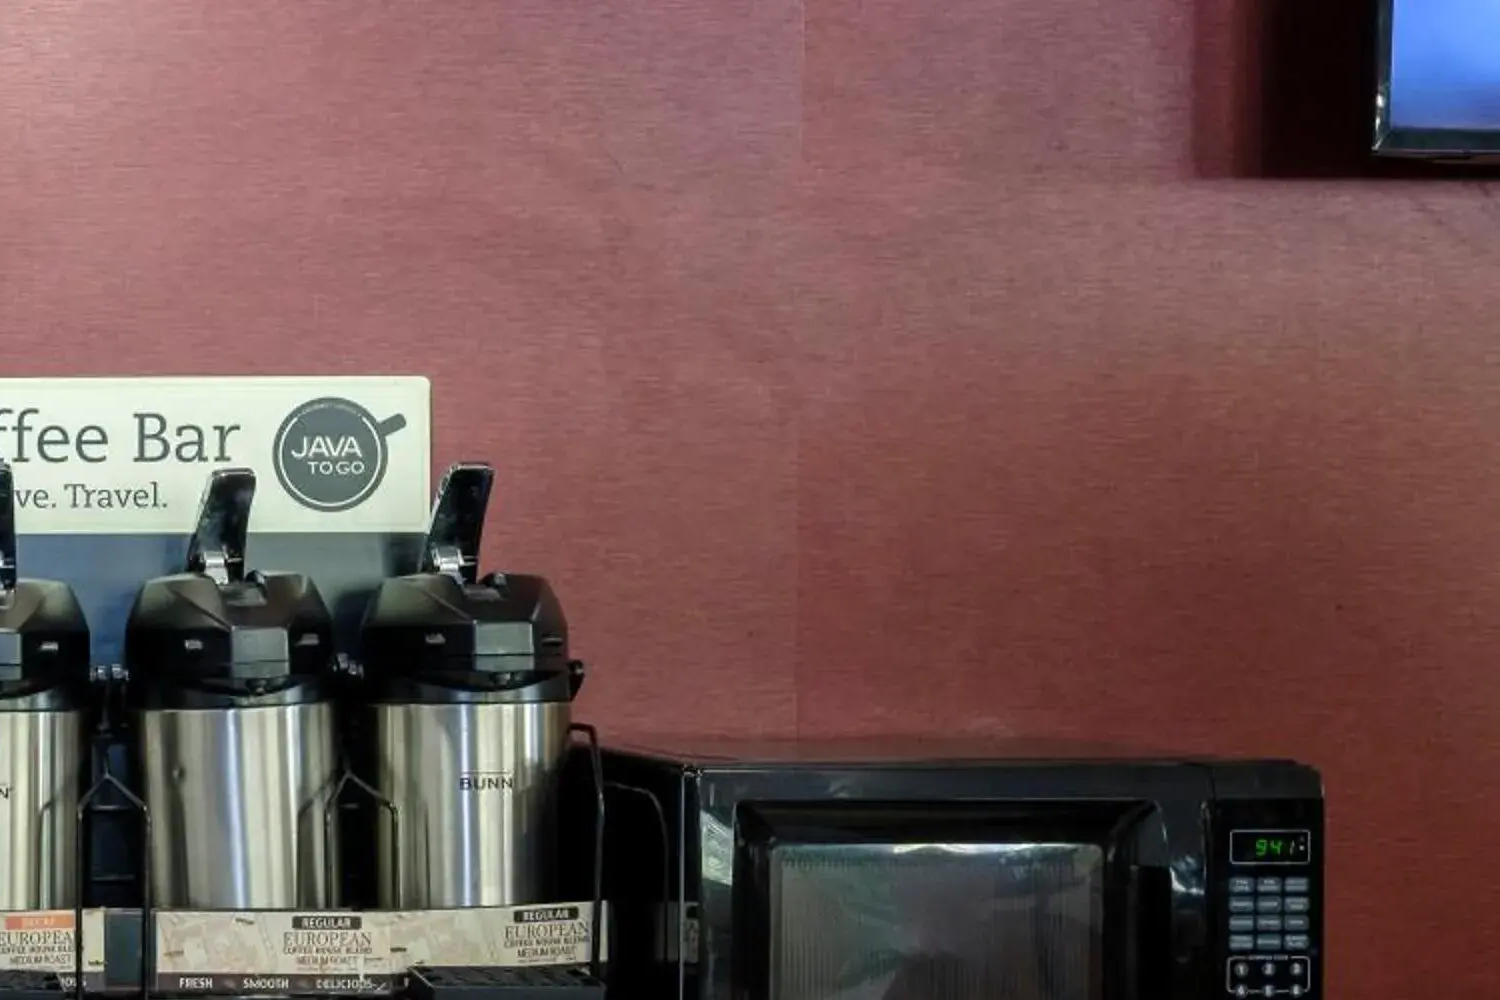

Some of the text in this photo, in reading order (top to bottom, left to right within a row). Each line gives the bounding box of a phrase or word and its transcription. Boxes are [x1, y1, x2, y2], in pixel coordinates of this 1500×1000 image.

[133, 411, 241, 463] Bar
[290, 435, 363, 459] JAVA
[307, 460, 365, 475] TO GO
[63, 481, 169, 509] Travel.
[459, 776, 513, 791] BUNN
[301, 916, 352, 929] REGULAR
[523, 909, 569, 921] REGULAR
[504, 921, 589, 940] EUROPEAN
[283, 931, 372, 947] EUROPEAN
[179, 977, 214, 989] FRESH
[243, 978, 290, 990] SMOOTH
